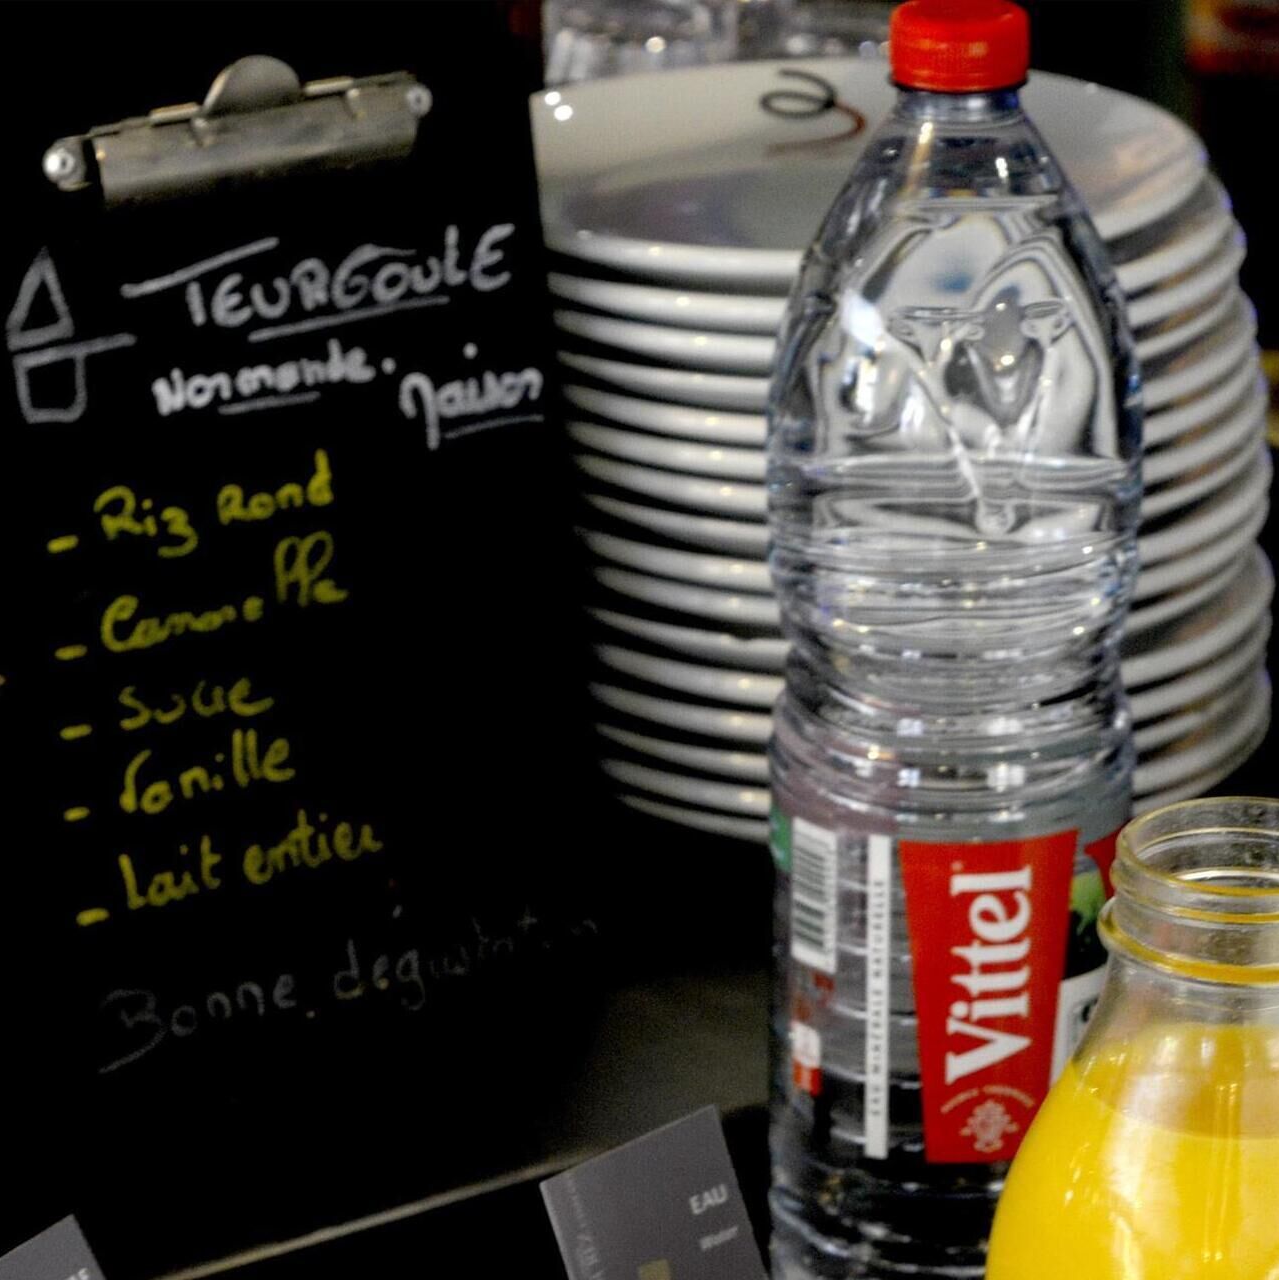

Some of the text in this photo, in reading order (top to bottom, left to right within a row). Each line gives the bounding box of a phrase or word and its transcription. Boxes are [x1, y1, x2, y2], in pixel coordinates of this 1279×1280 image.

[121, 222, 517, 327] TEURGOULE
[93, 449, 333, 557] Riz Rond
[945, 863, 1033, 1086] Vittel
[689, 1183, 729, 1216] EAU
